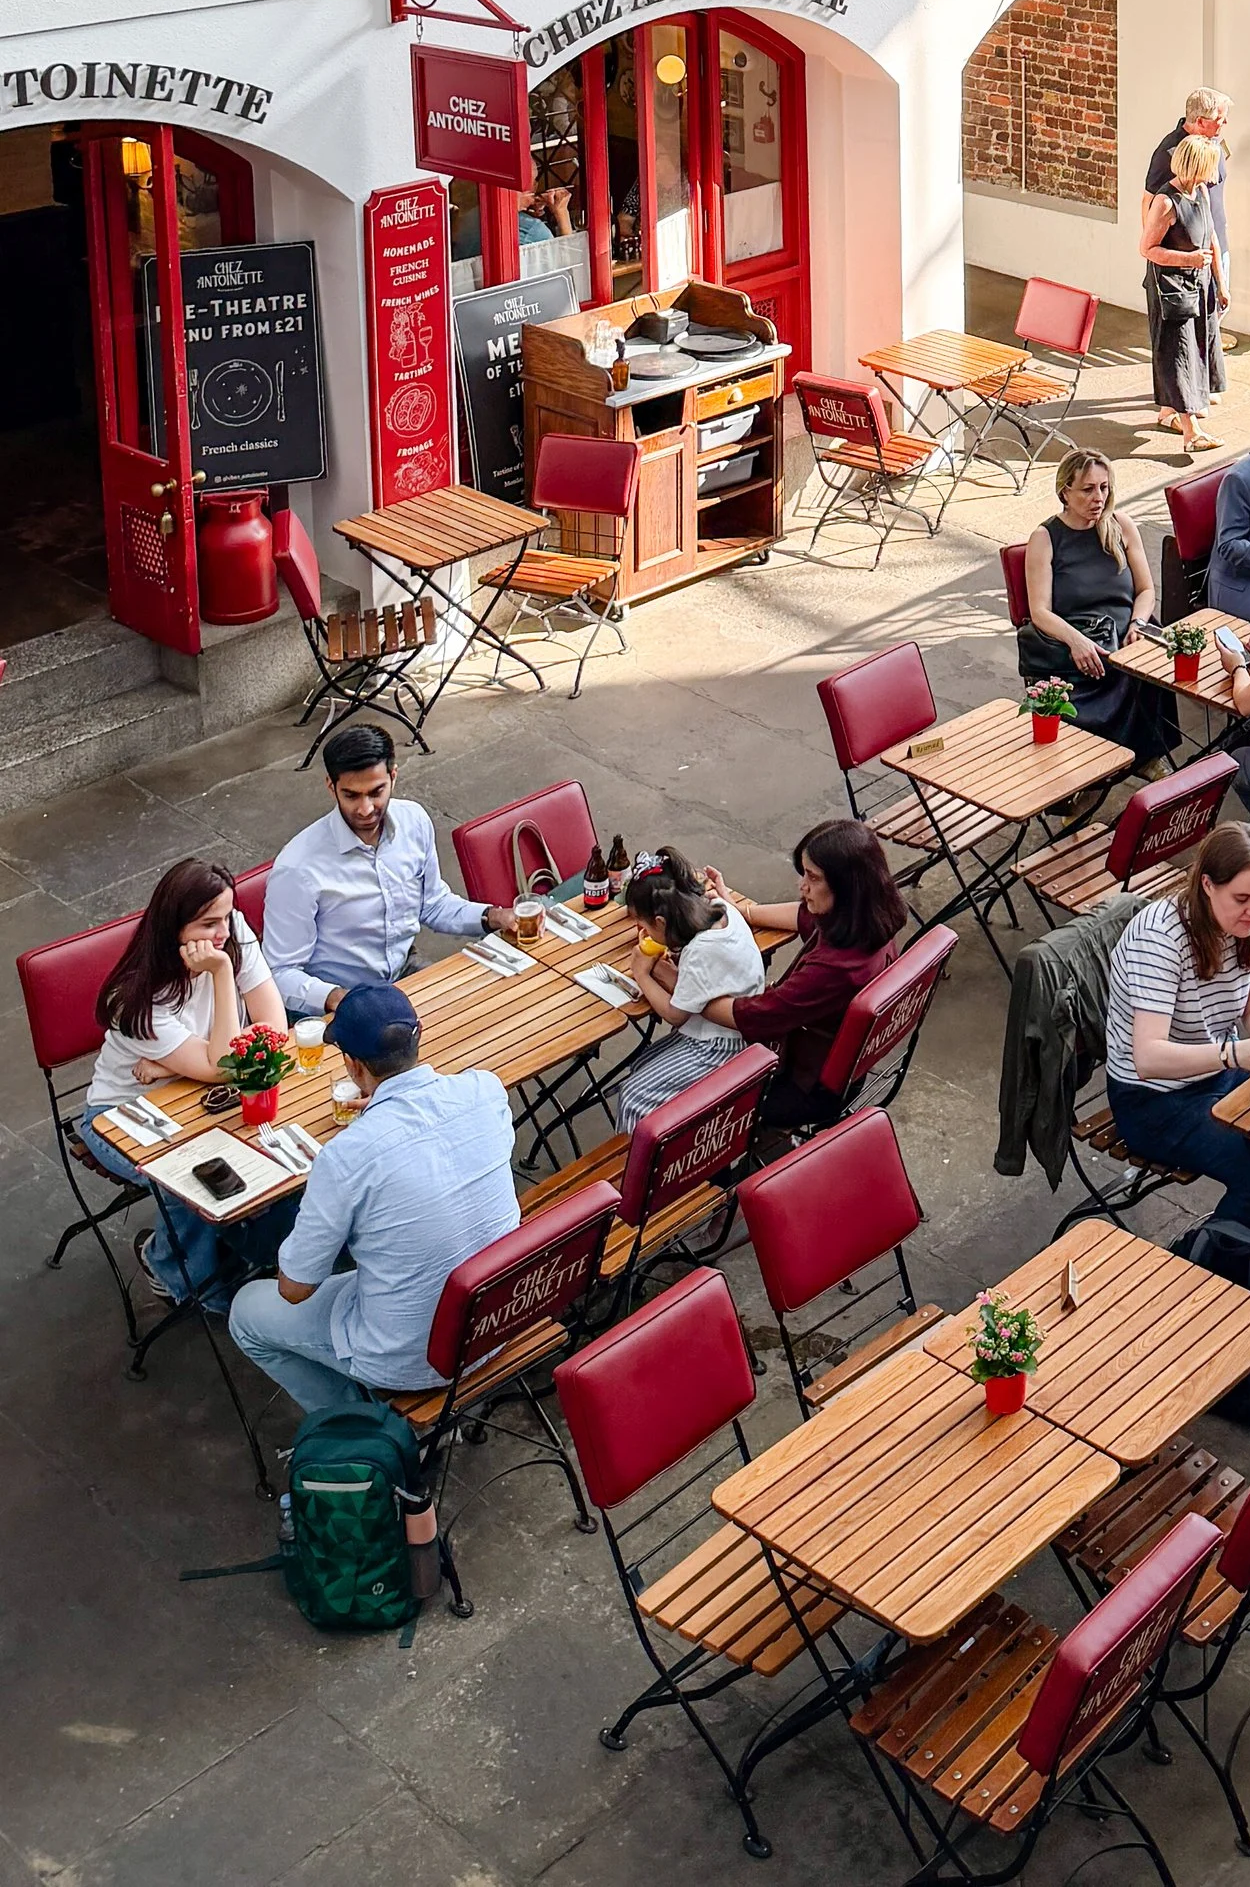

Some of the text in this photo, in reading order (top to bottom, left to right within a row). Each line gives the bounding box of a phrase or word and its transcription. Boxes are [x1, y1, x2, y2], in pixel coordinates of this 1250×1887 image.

[449, 95, 486, 118] CHEZ
[427, 110, 511, 143] ANTOINETTE
[395, 196, 419, 212] CHEZ
[380, 204, 436, 229] ANTOINETTE
[383, 236, 436, 257] HOMEMADE
[214, 261, 244, 275] CHEZ
[389, 258, 430, 276] FRENCH
[196, 271, 265, 289] ANTOINETTE
[392, 270, 427, 286] CUISINE
[381, 284, 440, 307] FRENCH WINES
[503, 295, 526, 311] CHEZ
[493, 302, 542, 326] ANTOINETTE
[221, 320, 271, 339] FROM
[274, 315, 303, 334] £21
[393, 363, 433, 382] TARTINES
[486, 364, 502, 380] OF
[820, 397, 847, 413] CHEZ
[808, 404, 869, 429] ANTOINETTE
[201, 437, 279, 457] French classics
[396, 438, 434, 458] FROMAGE
[694, 1106, 735, 1147] CHEZ
[660, 1108, 756, 1188] ANTOINETTE
[512, 1254, 563, 1299] CHEZ
[471, 1253, 589, 1342] ANTOINETTE
